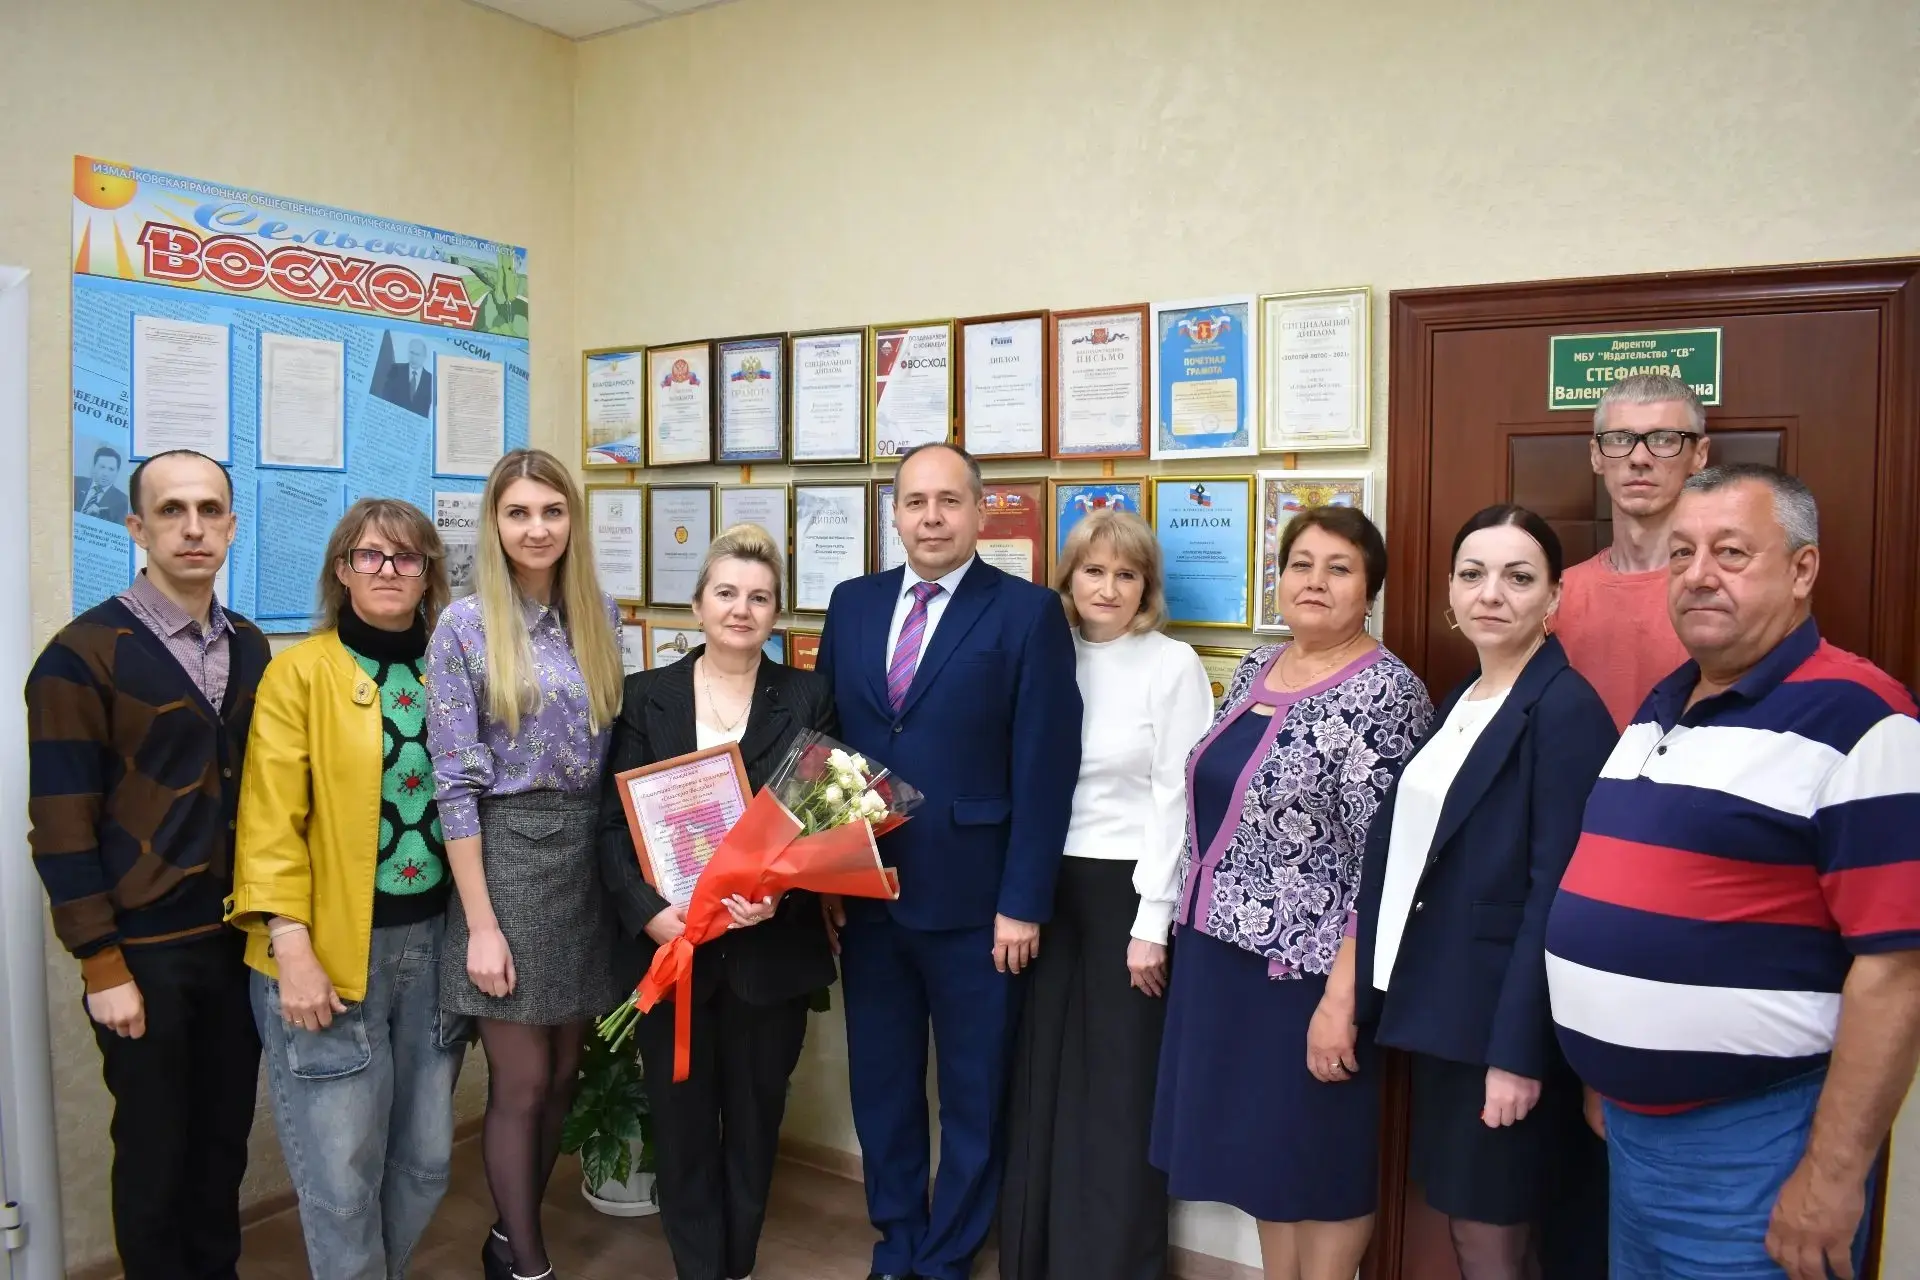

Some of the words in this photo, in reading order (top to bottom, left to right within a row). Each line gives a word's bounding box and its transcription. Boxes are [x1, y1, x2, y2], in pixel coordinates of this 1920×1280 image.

[93, 163, 188, 189] ИЗМАЛКОВСКАЯ
[189, 182, 249, 201] РАЙОННАЯ
[250, 194, 403, 233] ОБЩЕСТВЕННО-ПОЛИТИЧЕСКАЯ
[403, 226, 433, 239] ГАЗЕТА
[434, 232, 478, 249] ЛИПЕЦКОЙ
[479, 241, 515, 256] ОБЛАСТИ
[194, 202, 450, 264] Сельский
[137, 221, 480, 330] ВОСХОД
[1282, 317, 1350, 330] СПЕЦИАЛЬНЫЙ
[908, 334, 947, 342] ПОЗДРАВЛЯЕМ
[1297, 329, 1336, 338] ДИПЛОМ
[1612, 340, 1656, 351] Директор
[1077, 353, 1124, 363] ПИСЬМО
[1574, 352, 1595, 362] МБУ
[907, 358, 946, 369] ВОСХОД
[1186, 366, 1223, 376] ГРАМОТА
[878, 440, 895, 455] 90
[812, 516, 848, 525] ДИПЛОМ
[1169, 518, 1231, 528] ДИПЛОМ
